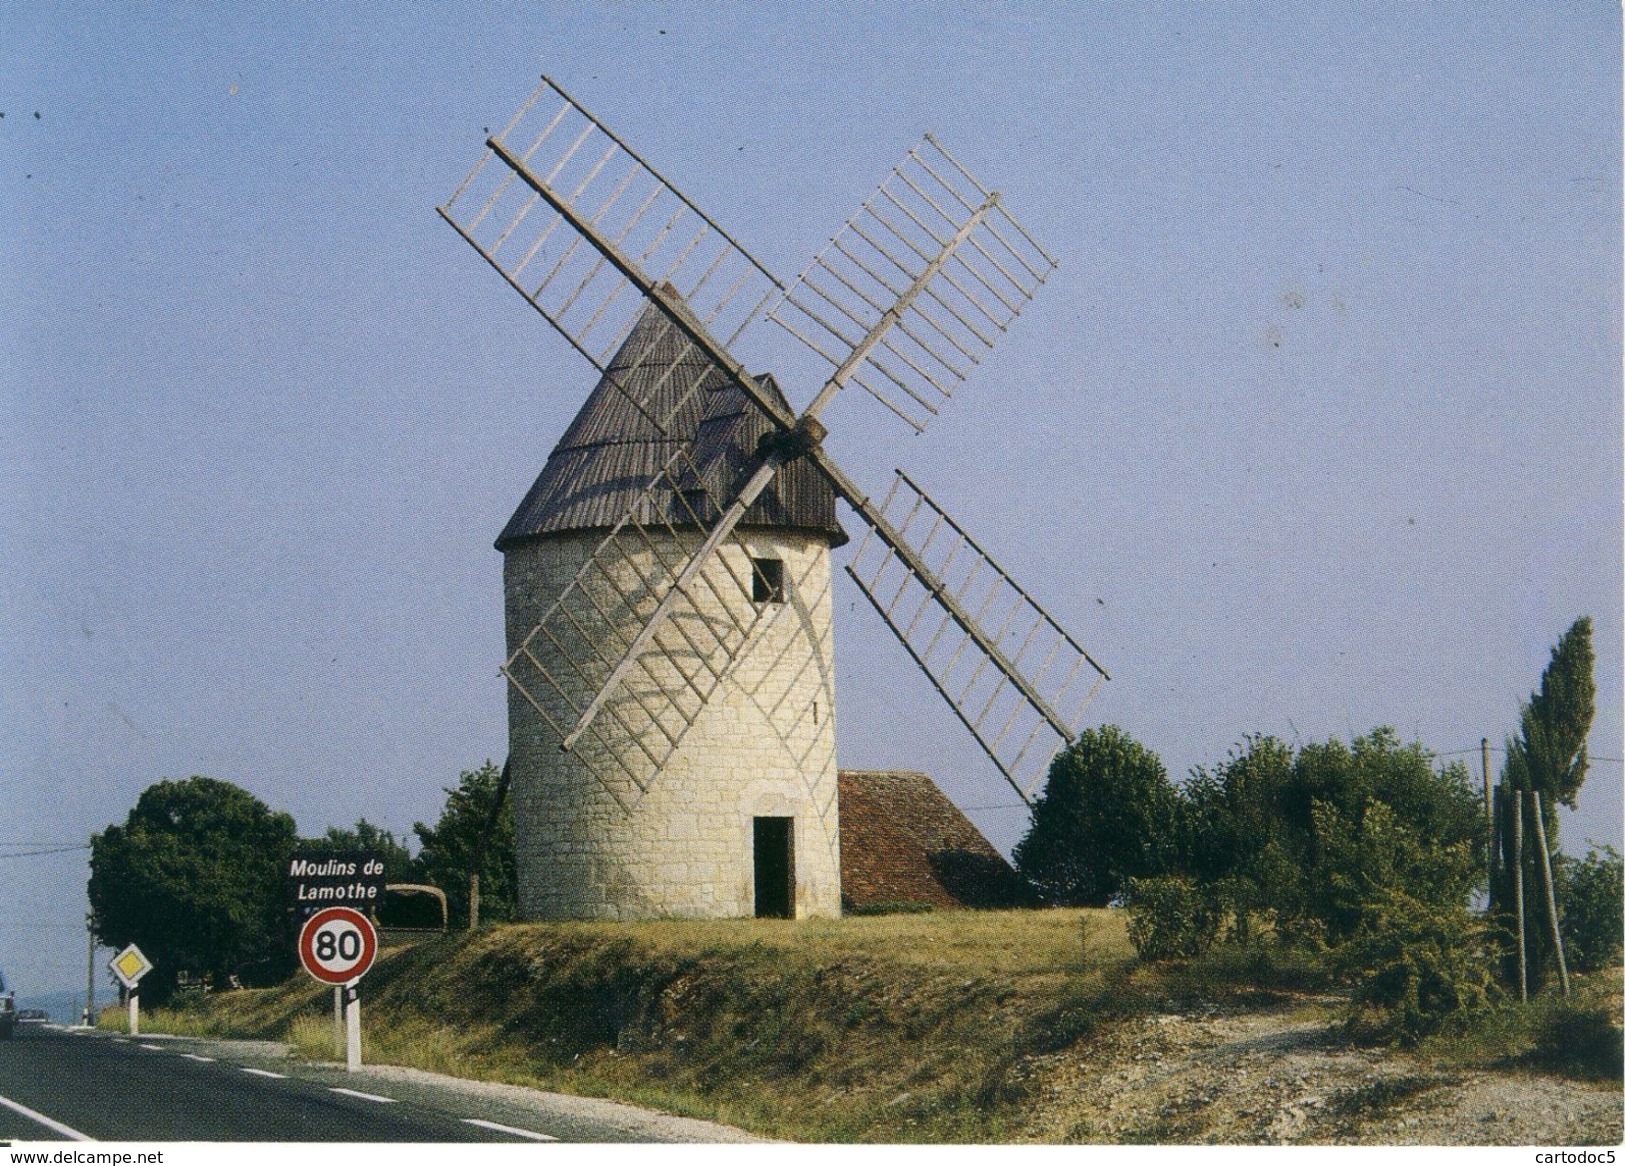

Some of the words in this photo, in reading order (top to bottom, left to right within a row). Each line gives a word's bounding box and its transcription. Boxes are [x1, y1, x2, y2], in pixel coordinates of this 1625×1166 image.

[290, 859, 357, 876] Moulins
[363, 859, 384, 875] de
[298, 883, 377, 900] Lamothe
[316, 930, 361, 962] 80
